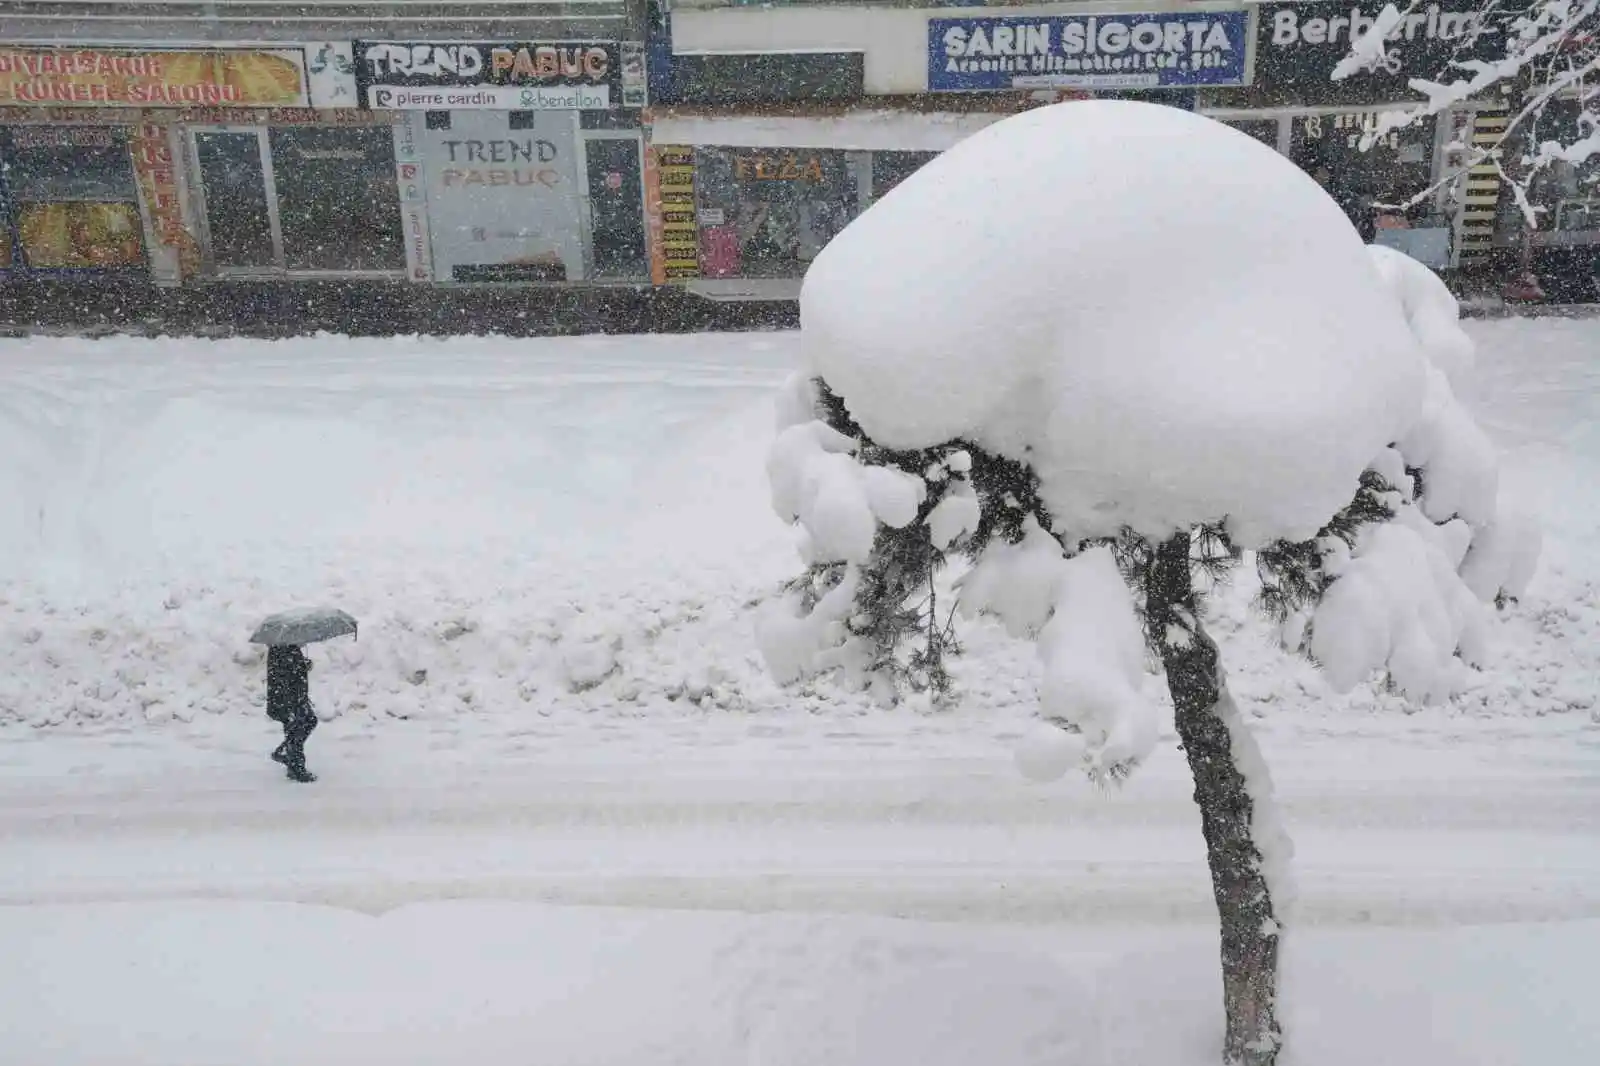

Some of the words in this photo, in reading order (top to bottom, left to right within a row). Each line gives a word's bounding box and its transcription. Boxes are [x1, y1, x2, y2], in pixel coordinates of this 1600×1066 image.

[943, 24, 1049, 56] SARIN
[1062, 17, 1231, 54] SİGORTA
[1272, 4, 1480, 45] Berbrim
[366, 44, 483, 77] TREND
[397, 91, 442, 107] pierre
[447, 89, 496, 105] cardin
[441, 139, 557, 163] TREND
